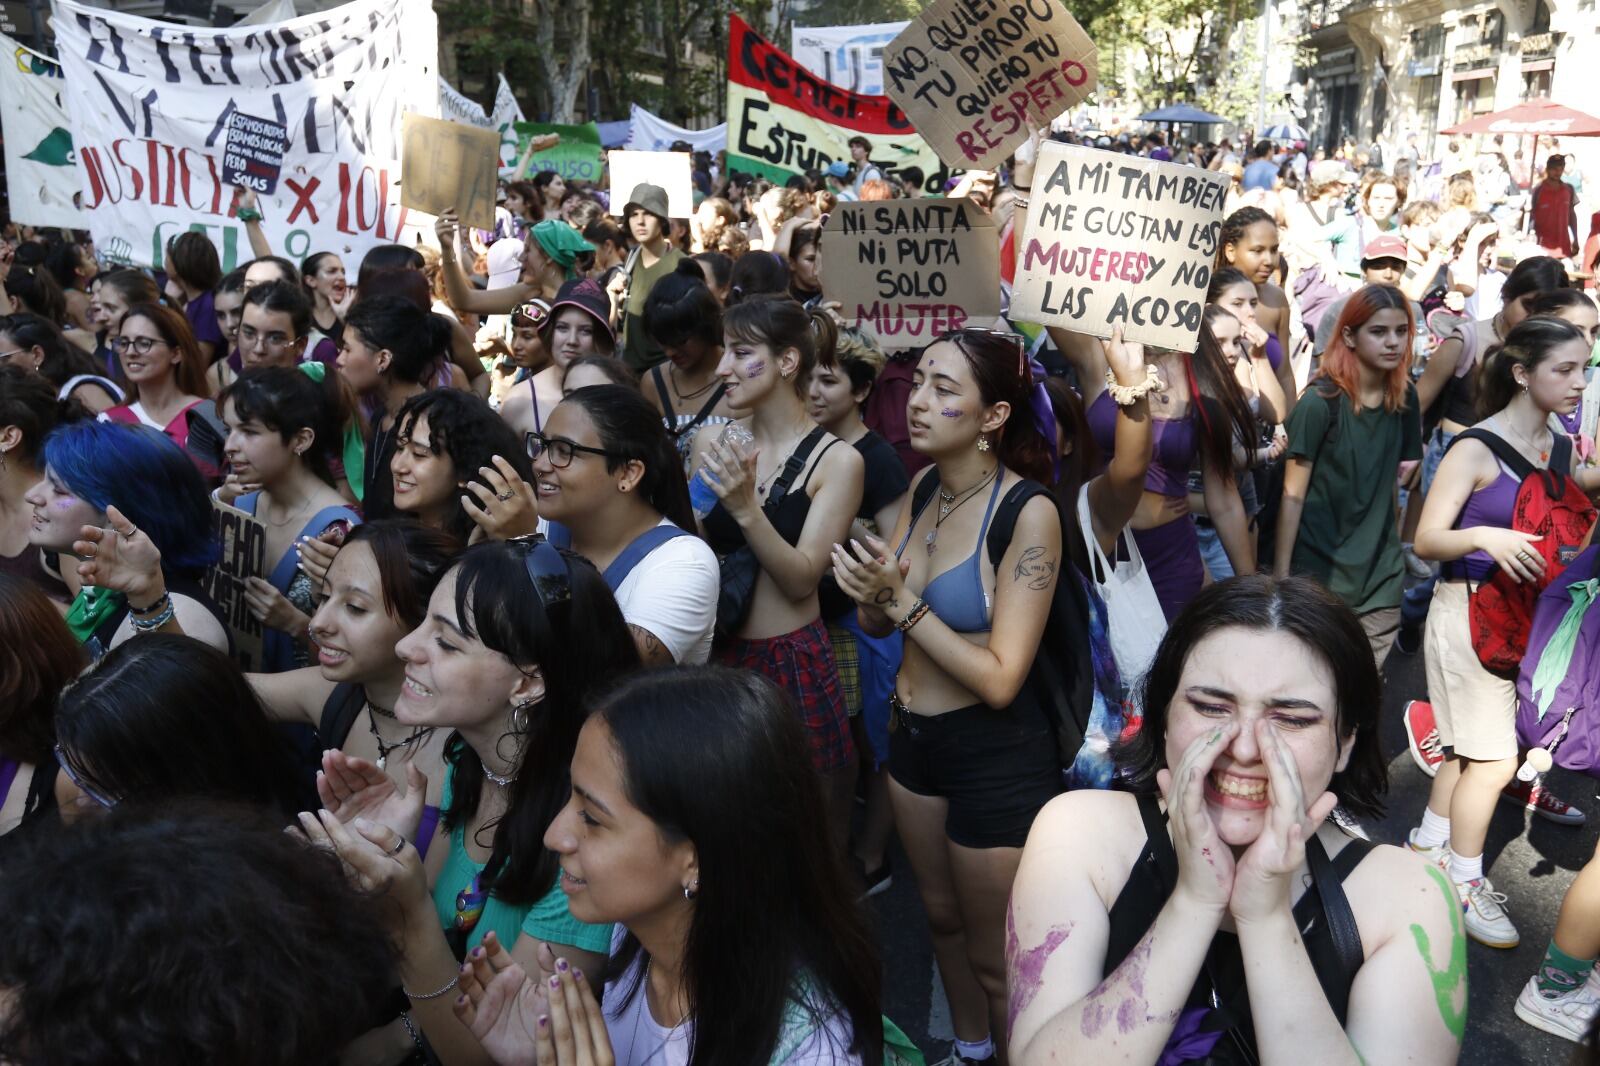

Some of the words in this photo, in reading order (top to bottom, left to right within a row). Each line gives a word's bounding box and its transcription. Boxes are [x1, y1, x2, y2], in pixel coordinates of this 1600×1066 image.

[887, 46, 929, 93] NO
[914, 69, 957, 109] TU
[960, 0, 1053, 73] PIROPO
[956, 55, 1031, 117] QUIERO
[1022, 33, 1060, 63] TU
[955, 60, 1088, 162] RESPETO
[225, 153, 247, 171] PERO
[232, 172, 268, 191] SOLAS
[1044, 160, 1071, 195] A
[875, 203, 971, 235] SANTA
[1039, 202, 1077, 231] ME
[1084, 206, 1183, 244] GUSTAN
[1188, 220, 1221, 257] LAS
[897, 238, 960, 266] PUTA
[1024, 238, 1148, 284] MUJERES
[1171, 261, 1211, 290] NO
[876, 269, 947, 298] SOLO
[856, 301, 968, 337] MUJER
[1041, 281, 1093, 319] LAS
[1106, 292, 1202, 332] ACOSO
